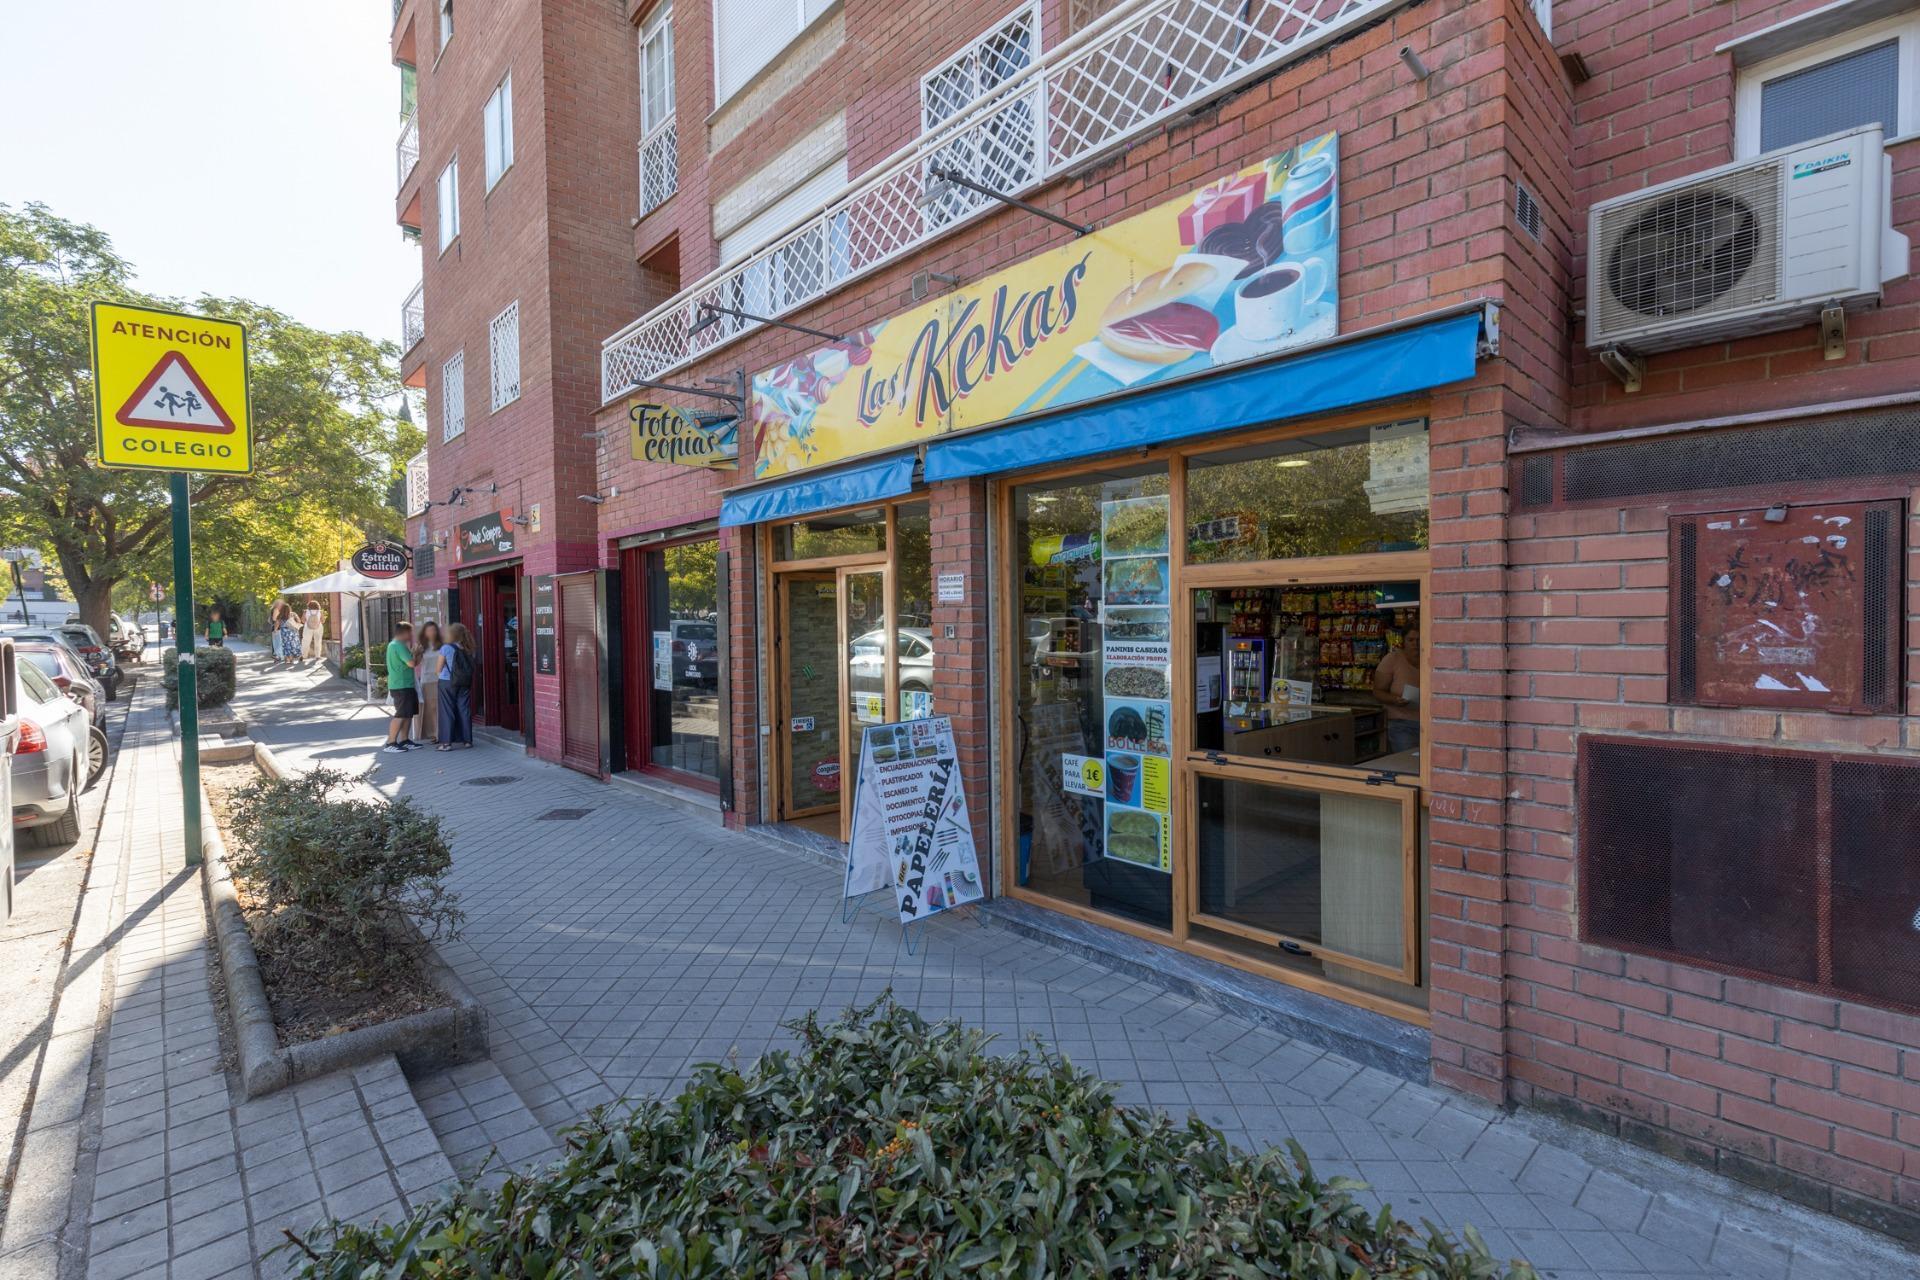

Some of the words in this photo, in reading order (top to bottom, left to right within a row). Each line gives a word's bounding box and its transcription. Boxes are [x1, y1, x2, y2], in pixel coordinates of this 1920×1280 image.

[1804, 152, 1850, 169] DAIKIN
[112, 320, 231, 349] ATENCIÓN
[898, 251, 1093, 428] Kekas
[629, 404, 683, 437] Foto
[122, 438, 232, 458] COLEGIO
[644, 430, 715, 464] copias
[361, 552, 401, 562] Estrella
[363, 561, 399, 571] Galicia
[1135, 646, 1168, 654] CASEROS
[1106, 654, 1145, 662] ELABORACIÓN
[879, 757, 939, 774] ENCUADERNACIONES
[881, 772, 924, 786] PLASTIFICADOS
[1064, 771, 1080, 779] PARA
[1086, 769, 1100, 781] 1€
[883, 788, 910, 798] ESCANEO
[1065, 781, 1086, 790] LLEVAR
[886, 796, 926, 811] DOCUMENTOS
[888, 809, 924, 824] FOTOCOPIAS
[890, 821, 928, 837] IMPRESIONES
[901, 756, 954, 917] PAPELERÍA
